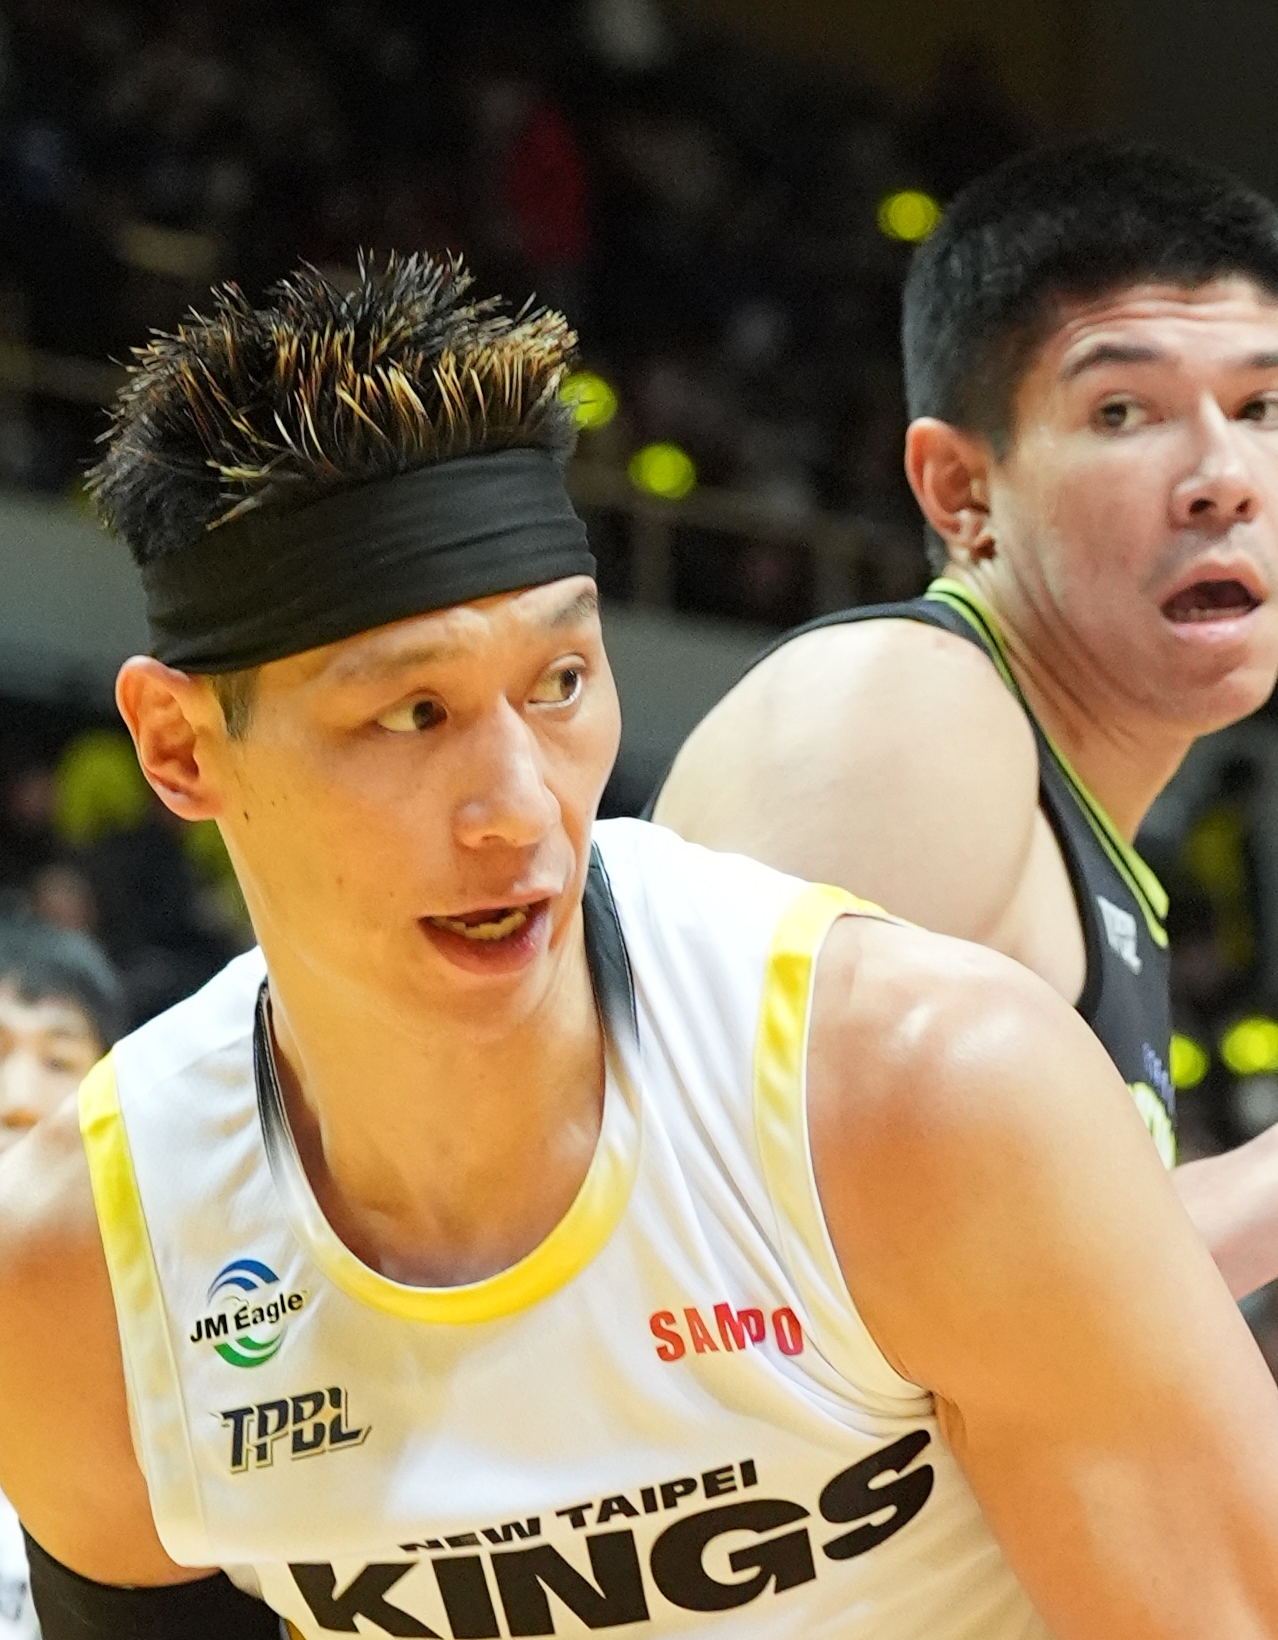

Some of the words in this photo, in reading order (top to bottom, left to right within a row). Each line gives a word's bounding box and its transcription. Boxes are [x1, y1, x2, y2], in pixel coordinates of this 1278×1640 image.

[190, 1314, 229, 1342] JM
[234, 1291, 304, 1331] Eagle
[212, 1386, 371, 1474] TPBL
[556, 1459, 759, 1529] TAIPEI
